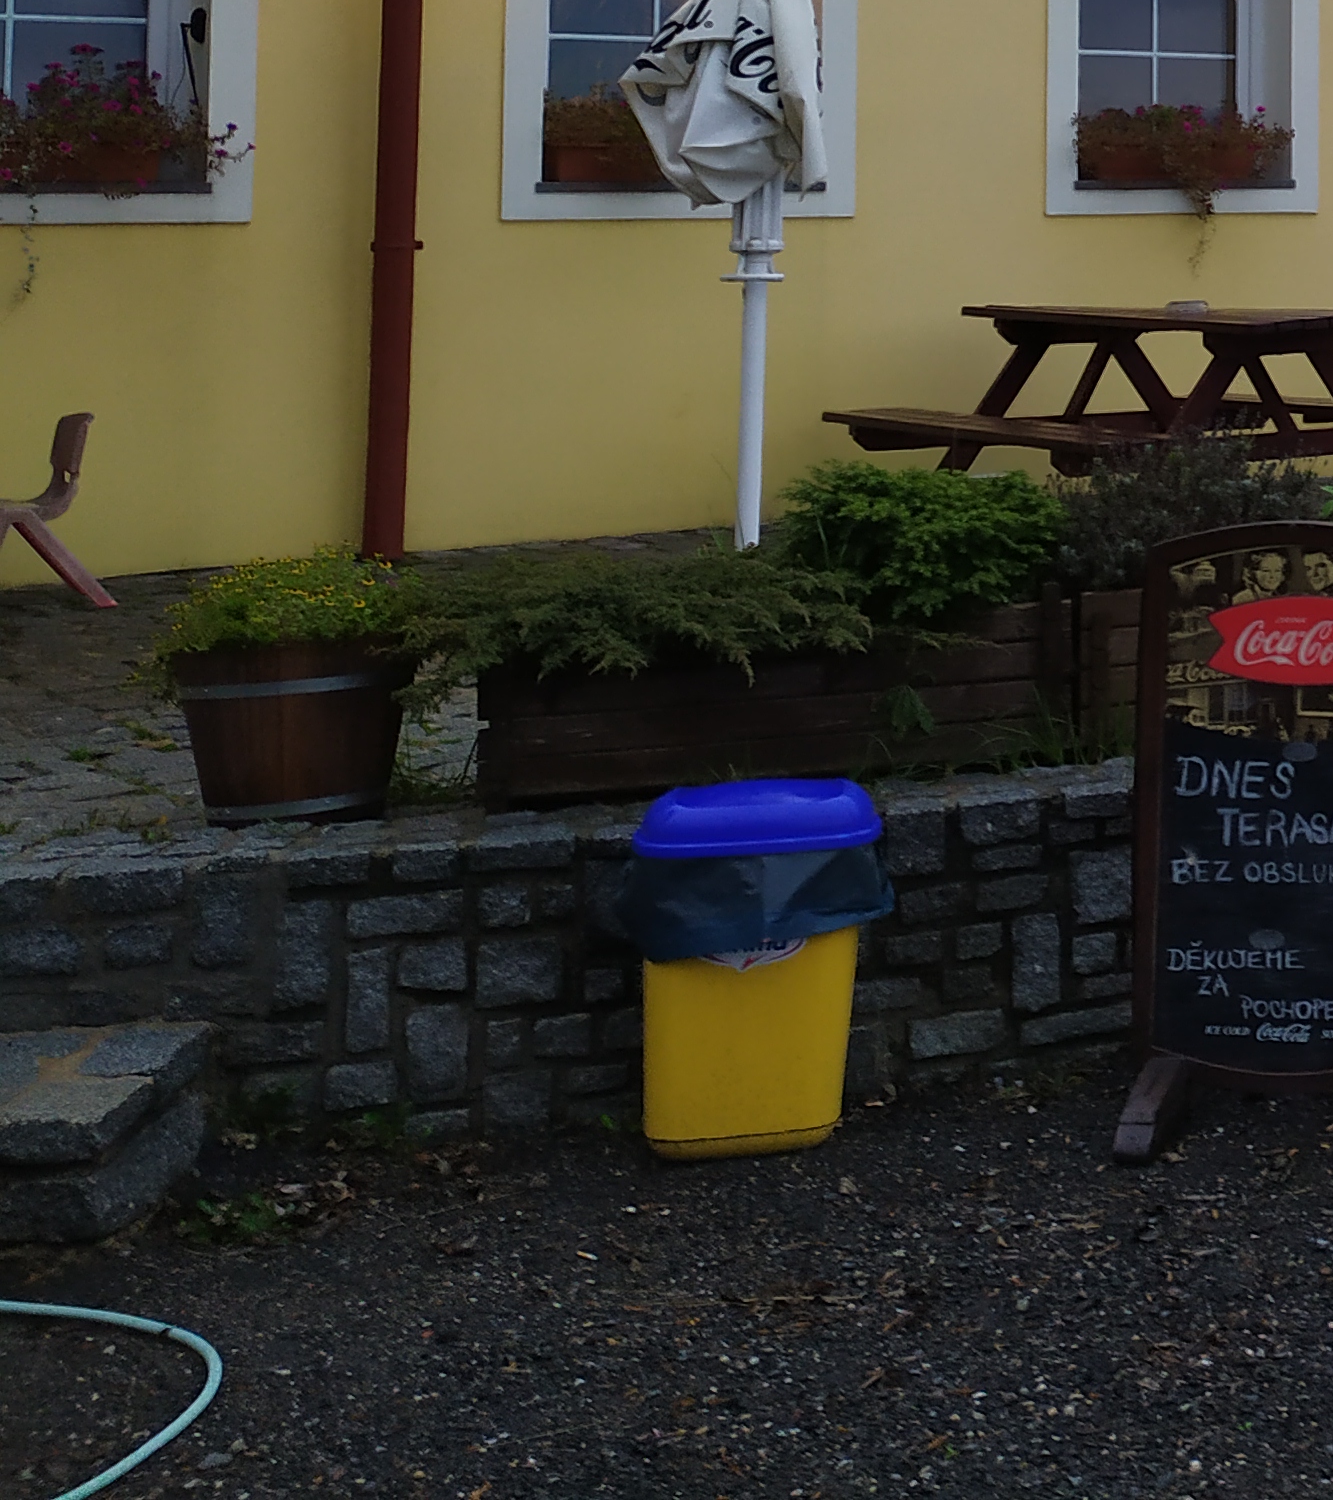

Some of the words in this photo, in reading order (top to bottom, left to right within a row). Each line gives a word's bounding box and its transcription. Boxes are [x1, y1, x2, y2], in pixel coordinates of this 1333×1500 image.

[1174, 754, 1298, 800] DNES
[1171, 858, 1234, 885] BEZ
[1197, 973, 1231, 998] ZA
[1255, 1022, 1313, 1044] Coca-Cola
